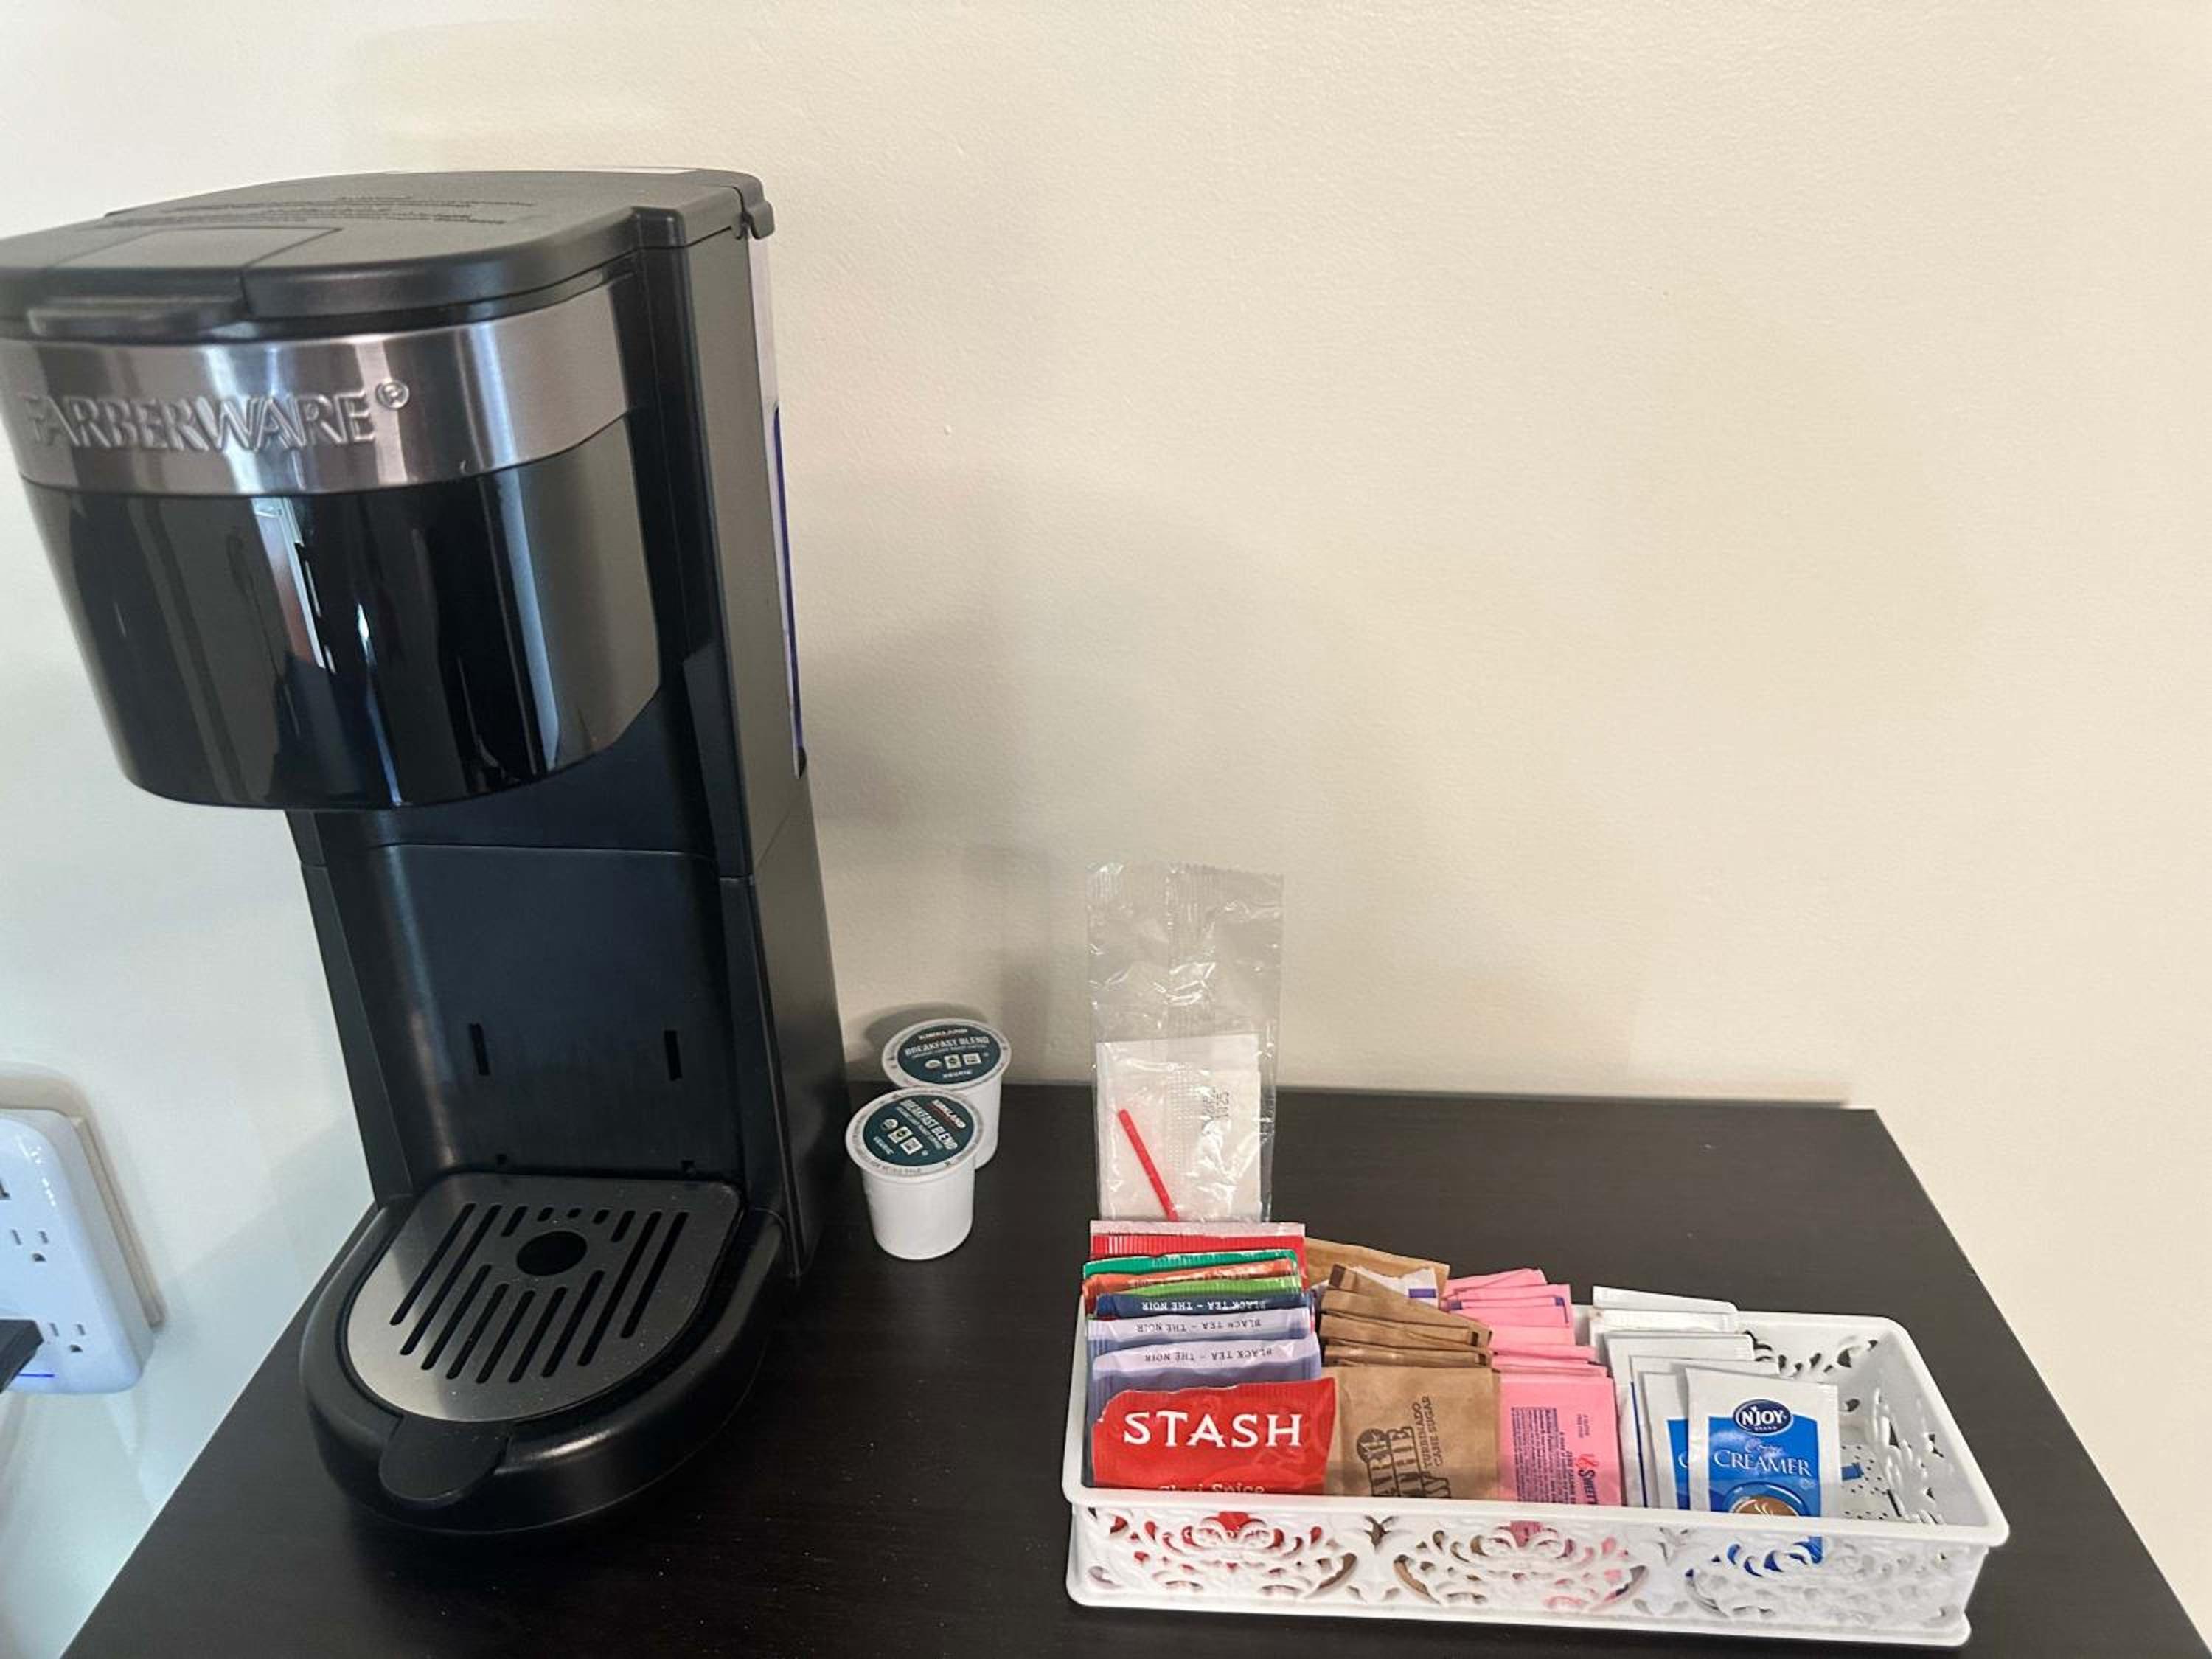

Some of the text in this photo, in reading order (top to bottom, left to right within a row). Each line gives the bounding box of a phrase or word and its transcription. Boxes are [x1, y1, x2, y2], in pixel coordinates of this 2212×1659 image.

[905, 1039, 958, 1056] BREAKFAST
[959, 1036, 990, 1046] BLEND
[900, 1099, 939, 1129] BREAKFAST
[931, 1125, 958, 1150] BLEND
[1142, 1301, 1168, 1311] NOIR
[1207, 1301, 1228, 1310] TEA
[1227, 1301, 1266, 1310] BLACK
[1201, 1322, 1222, 1330] TEA
[1145, 1353, 1171, 1362] NOIR
[1211, 1352, 1234, 1360] TEA
[1236, 1348, 1272, 1360] BLACK
[1422, 1396, 1437, 1433] SUGAR
[1124, 1411, 1303, 1447] STASH
[1412, 1402, 1432, 1469] TURBINADO
[1430, 1433, 1443, 1467] CANE
[1714, 1450, 1812, 1477] CREAMER
